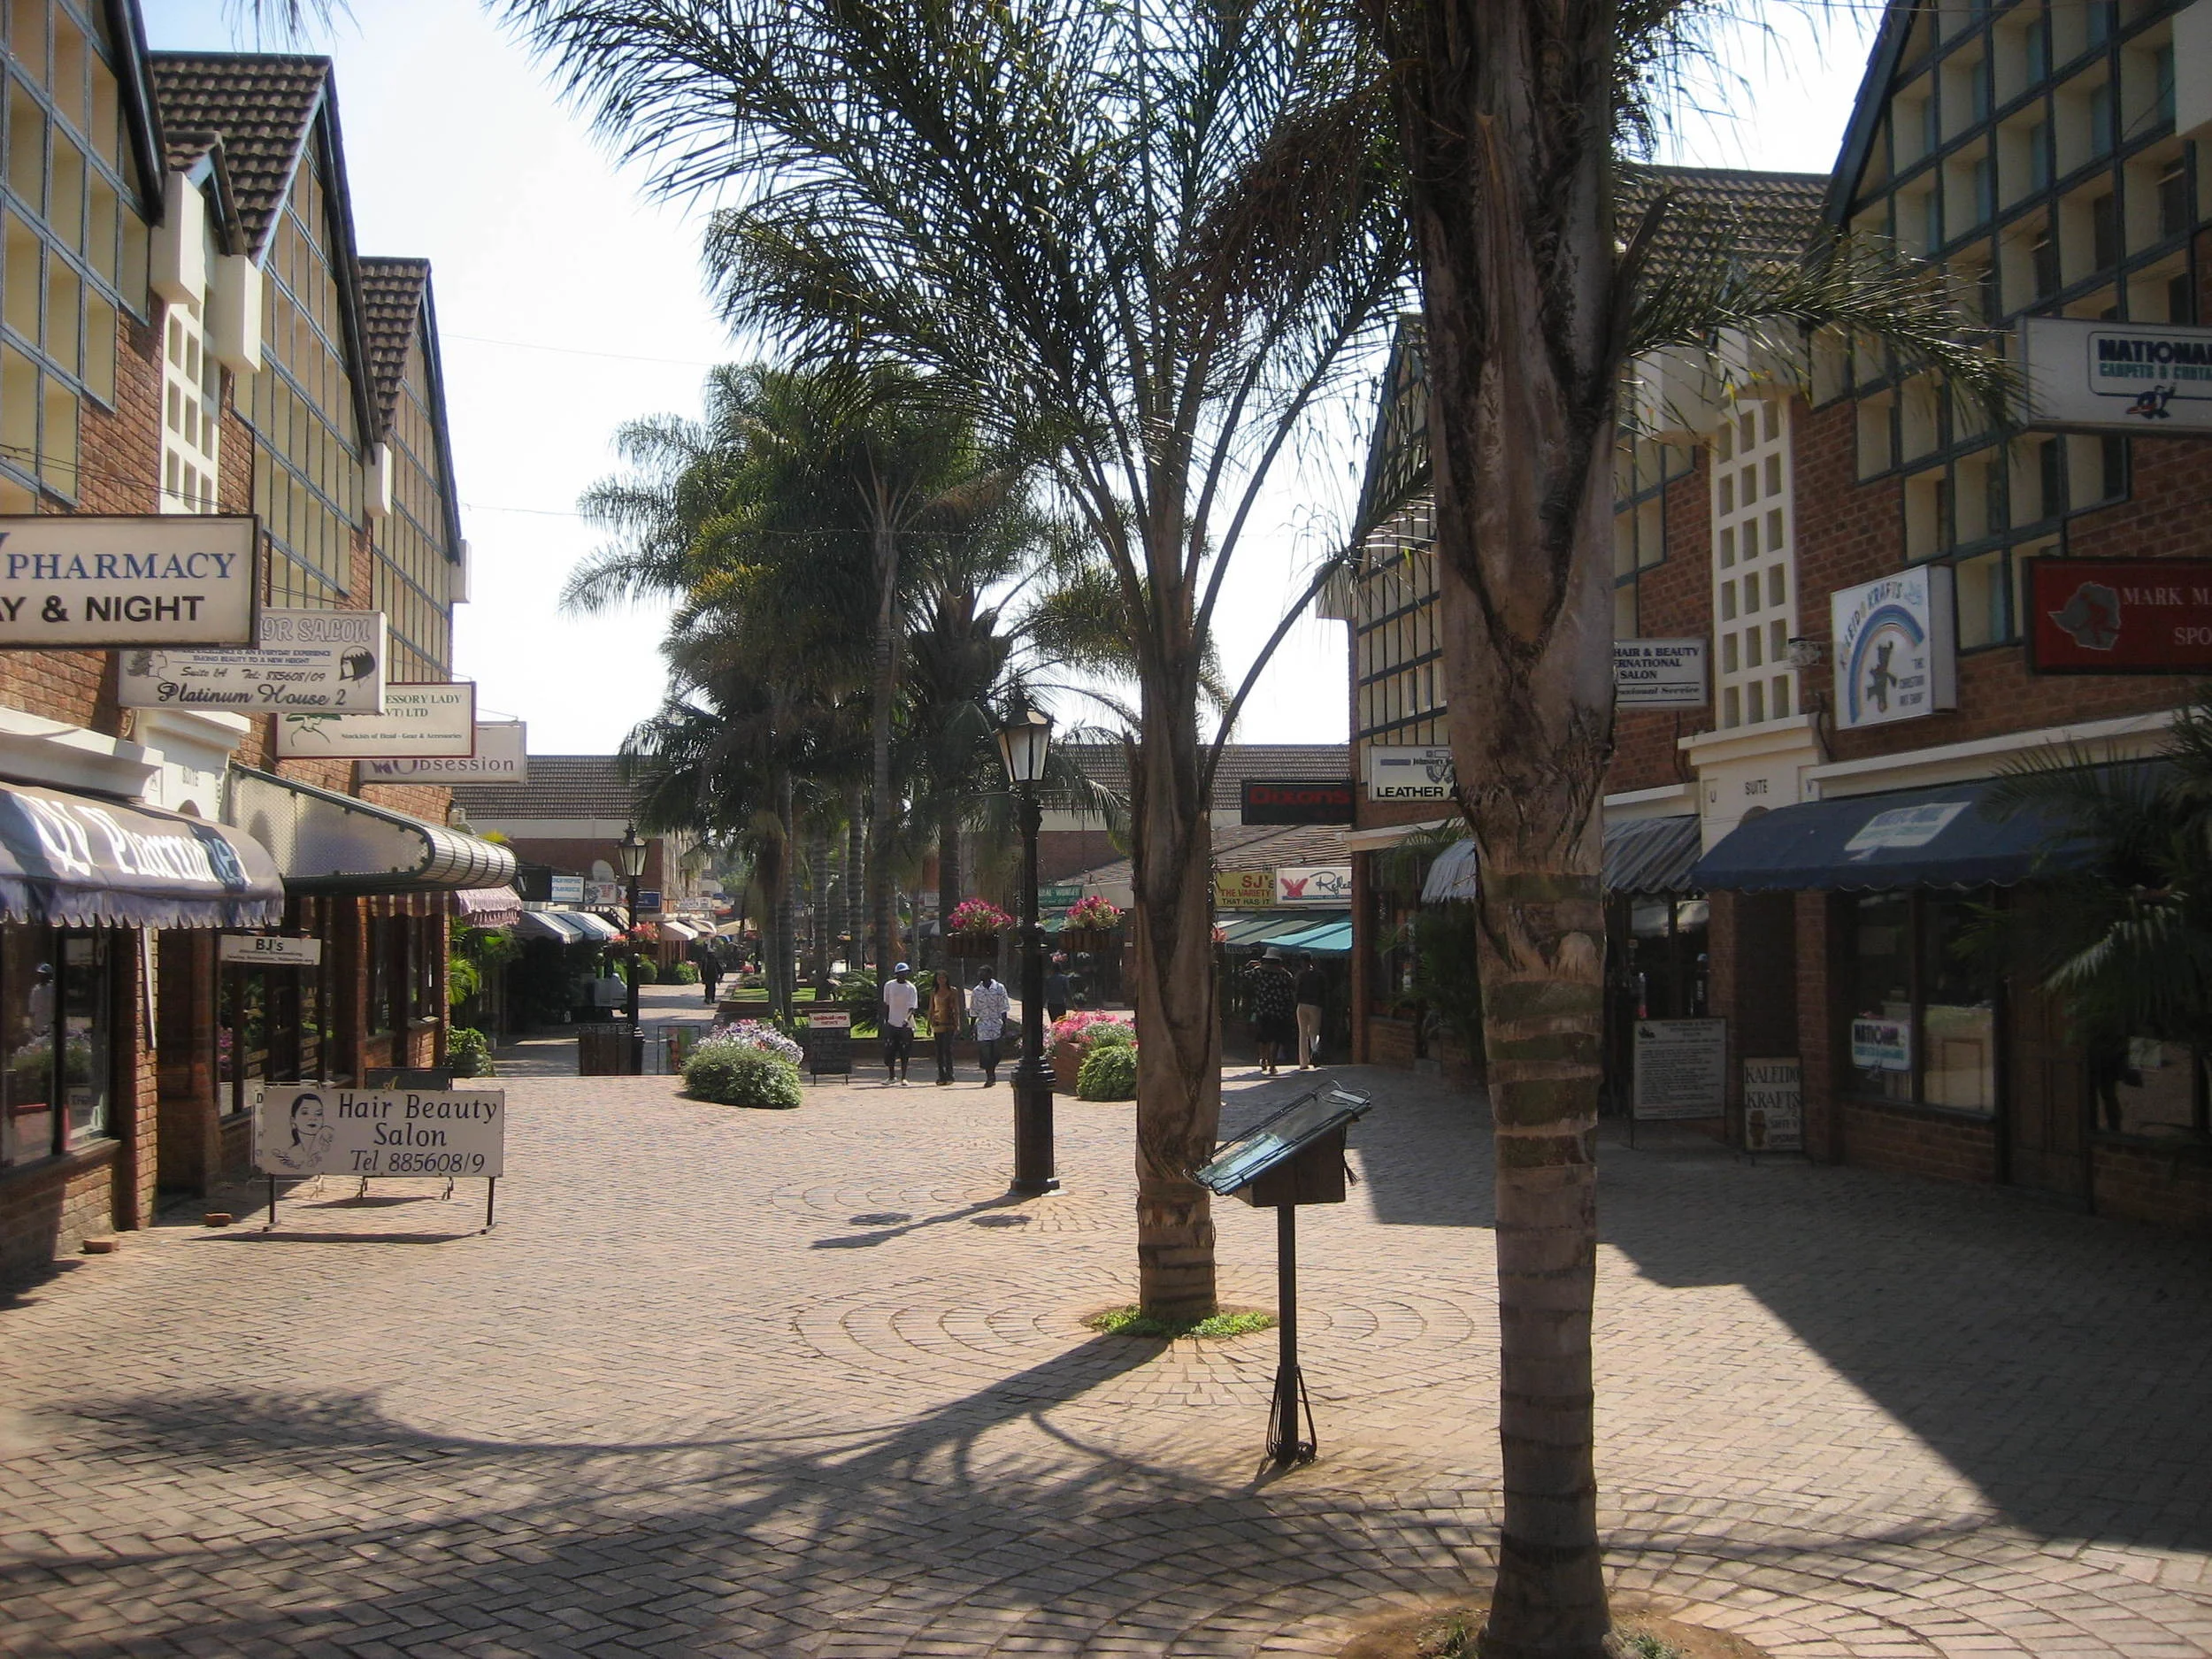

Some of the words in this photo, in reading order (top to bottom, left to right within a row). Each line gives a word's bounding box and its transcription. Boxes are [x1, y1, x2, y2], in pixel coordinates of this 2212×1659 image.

[7, 553, 236, 579] PHARMACY
[2124, 588, 2184, 605] MARK
[2191, 588, 2212, 605] M
[0, 596, 27, 622] Y
[42, 595, 69, 623] &
[86, 595, 205, 622] NIGHT
[298, 618, 371, 642] SALON
[1614, 648, 1640, 657] HAIR
[1643, 648, 1652, 657] &
[1655, 647, 1699, 657] BEAUTY
[1620, 670, 1657, 680] SALON
[157, 681, 253, 707] Platinum
[257, 684, 330, 706] House
[336, 688, 346, 706] 2
[431, 695, 462, 704] LADY
[406, 708, 428, 718] LTD
[1377, 787, 1444, 797] LEATHER
[1745, 779, 1768, 795] SUITE
[1241, 875, 1274, 888] SJ's
[256, 938, 284, 951] BJ's
[339, 1093, 393, 1118] Hair
[404, 1094, 497, 1124] Beauty
[373, 1122, 447, 1147] Salon
[350, 1150, 379, 1171] Tel
[388, 1151, 485, 1173] 885608/9
